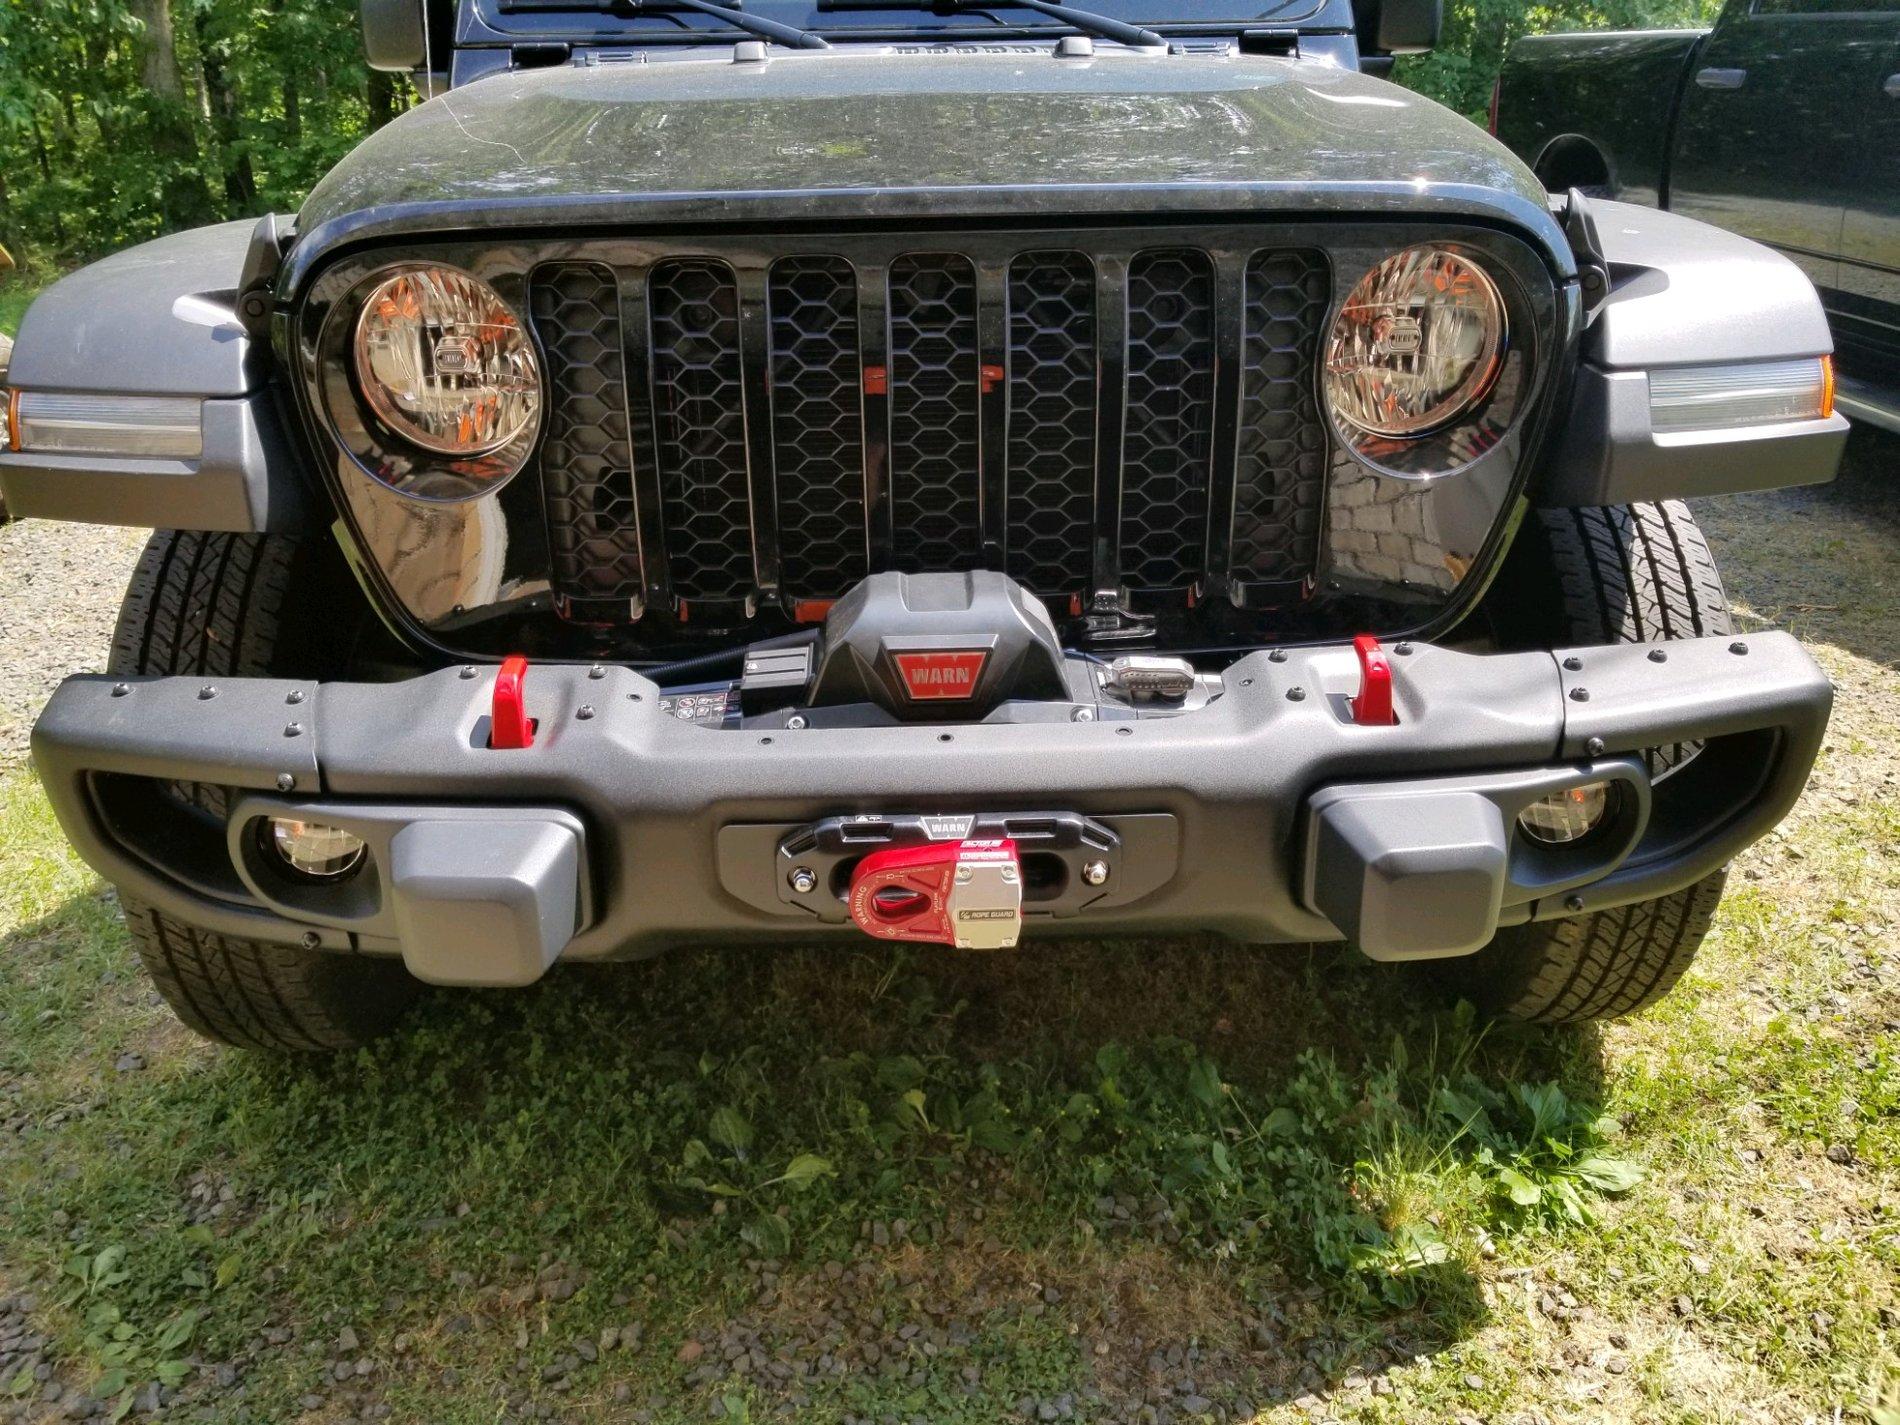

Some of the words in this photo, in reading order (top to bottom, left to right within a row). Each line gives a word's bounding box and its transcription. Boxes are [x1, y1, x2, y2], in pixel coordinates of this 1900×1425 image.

[911, 667, 970, 684] WARN
[931, 823, 966, 832] WARN
[853, 885, 869, 925] WARNING
